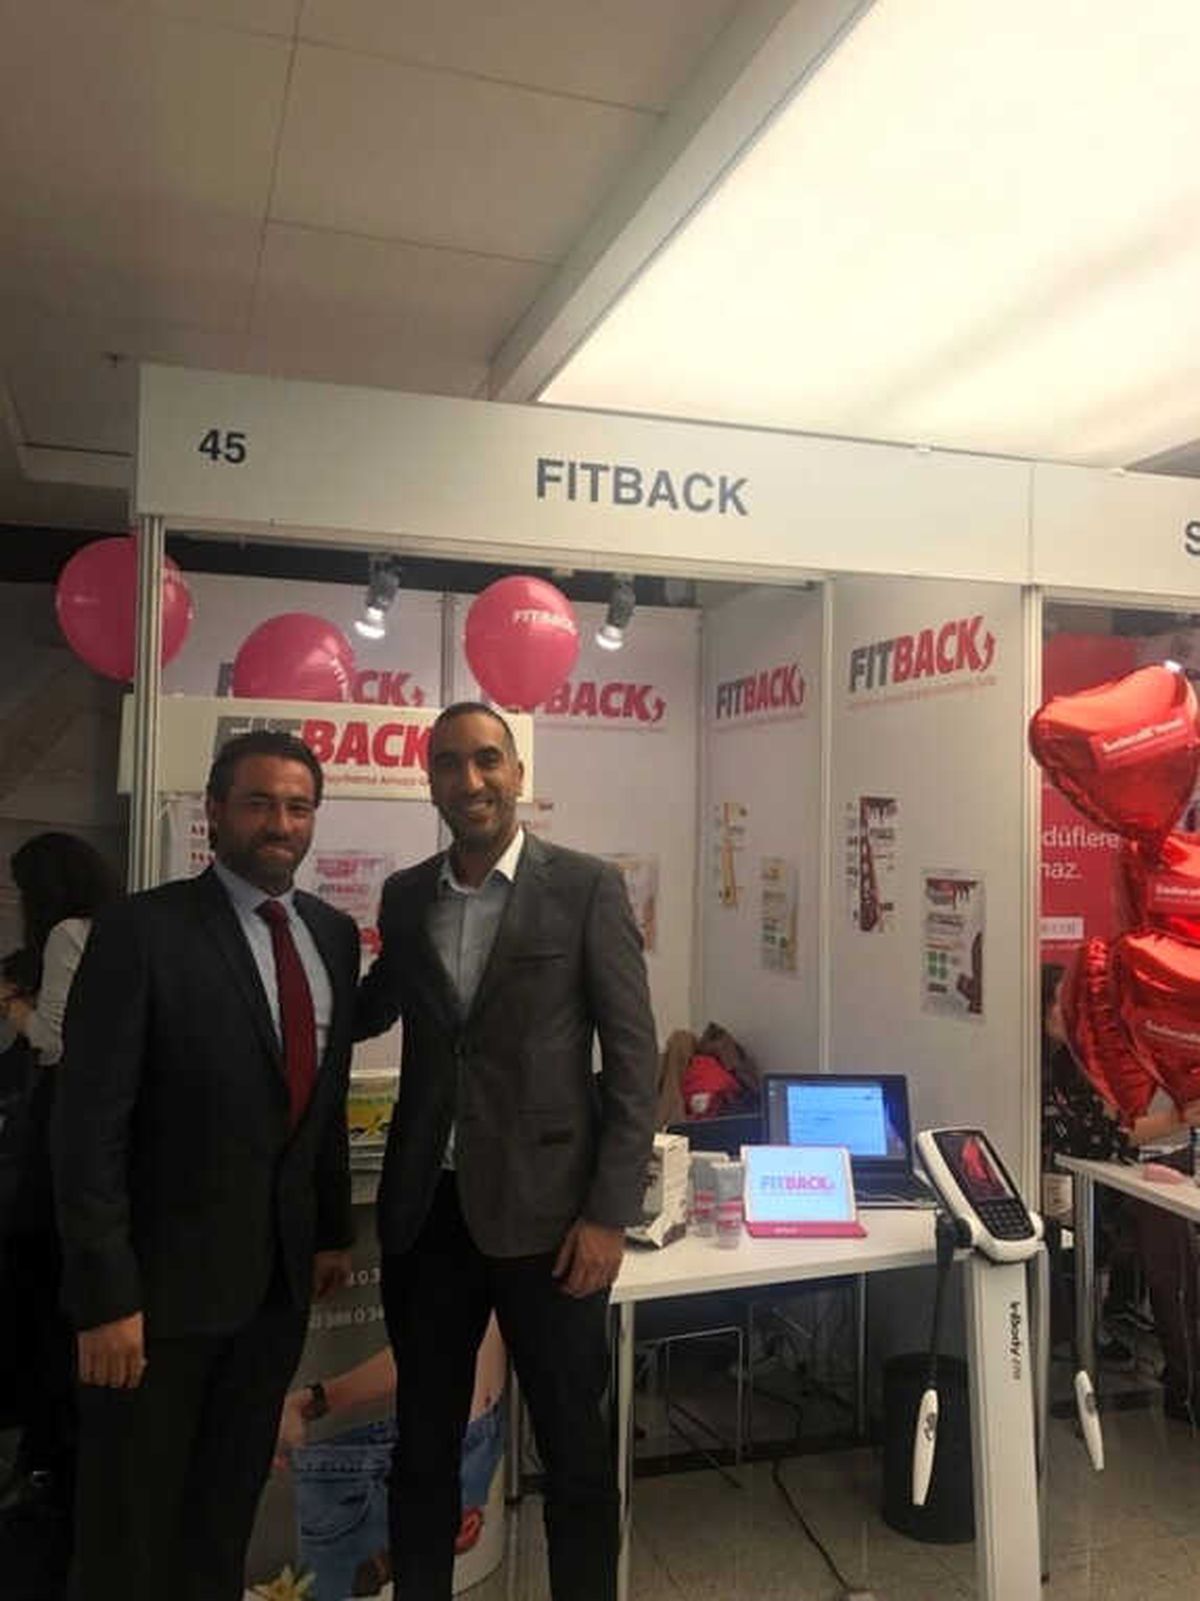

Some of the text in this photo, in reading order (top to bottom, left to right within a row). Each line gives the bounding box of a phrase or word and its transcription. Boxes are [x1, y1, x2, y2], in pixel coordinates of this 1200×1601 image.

[198, 429, 247, 464] 45
[536, 457, 749, 516] FITBACK
[850, 615, 984, 693] FITBACK
[543, 681, 653, 721] BACK
[716, 665, 801, 719] FITBACK
[214, 716, 434, 768] BACK
